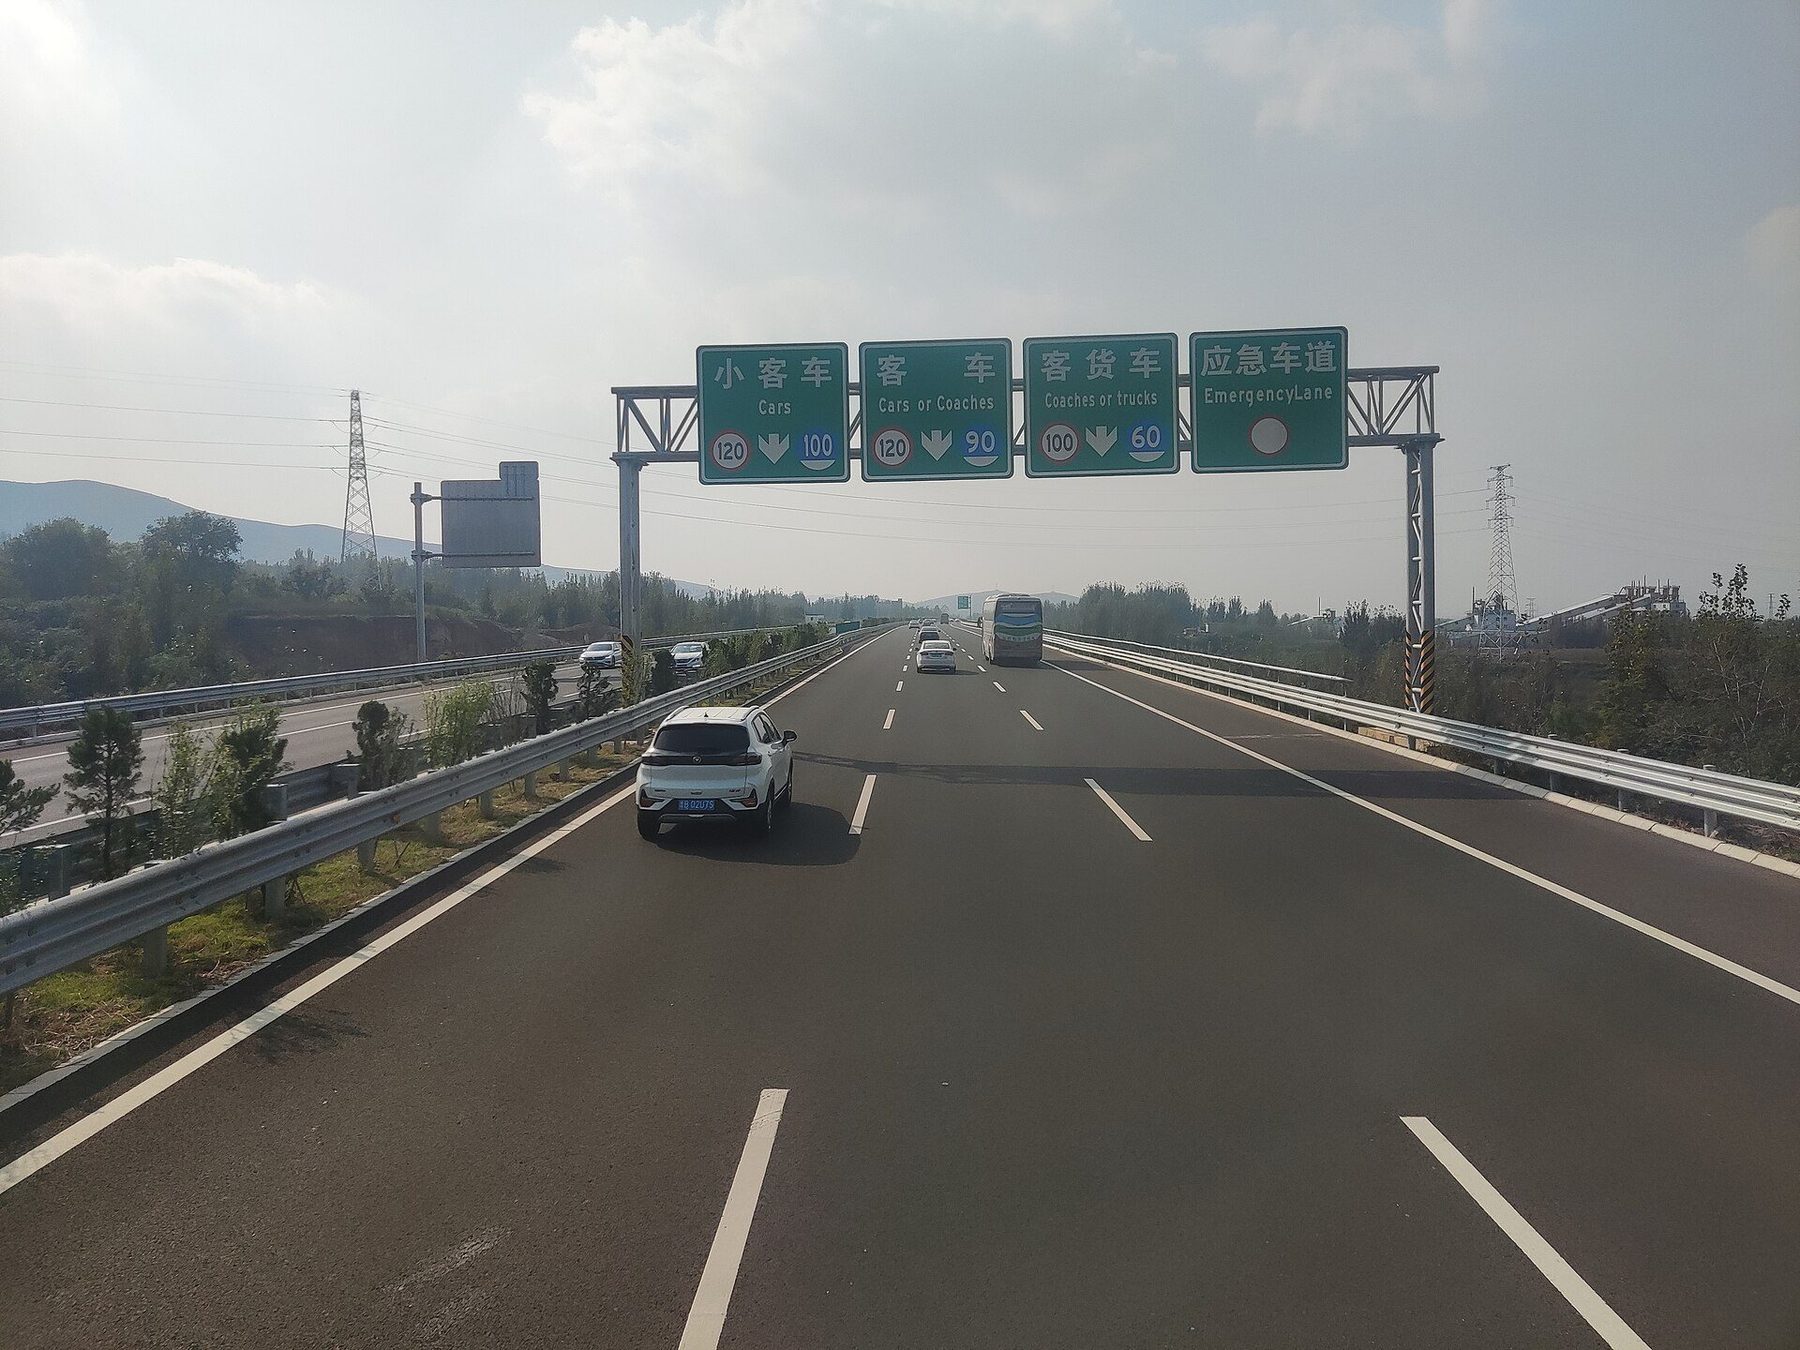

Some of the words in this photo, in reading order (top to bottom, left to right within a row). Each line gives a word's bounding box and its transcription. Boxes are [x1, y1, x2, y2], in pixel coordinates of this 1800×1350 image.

[1040, 348, 1162, 382] 客货车
[1201, 341, 1337, 377] 应急车道
[714, 357, 832, 389] 小客车
[879, 397, 909, 413] Cars
[918, 398, 931, 411] or
[937, 395, 994, 411] Coaches
[1045, 392, 1096, 408] Coaches
[1100, 392, 1112, 406] or
[1117, 390, 1158, 406] trucks
[1204, 385, 1333, 406] EmergencyLane
[759, 399, 791, 415] Cars
[803, 433, 833, 457] 100
[965, 430, 996, 453] 90
[1046, 433, 1074, 452] 100
[1131, 425, 1162, 448] 60
[718, 441, 744, 461] 120
[879, 438, 905, 457] 120
